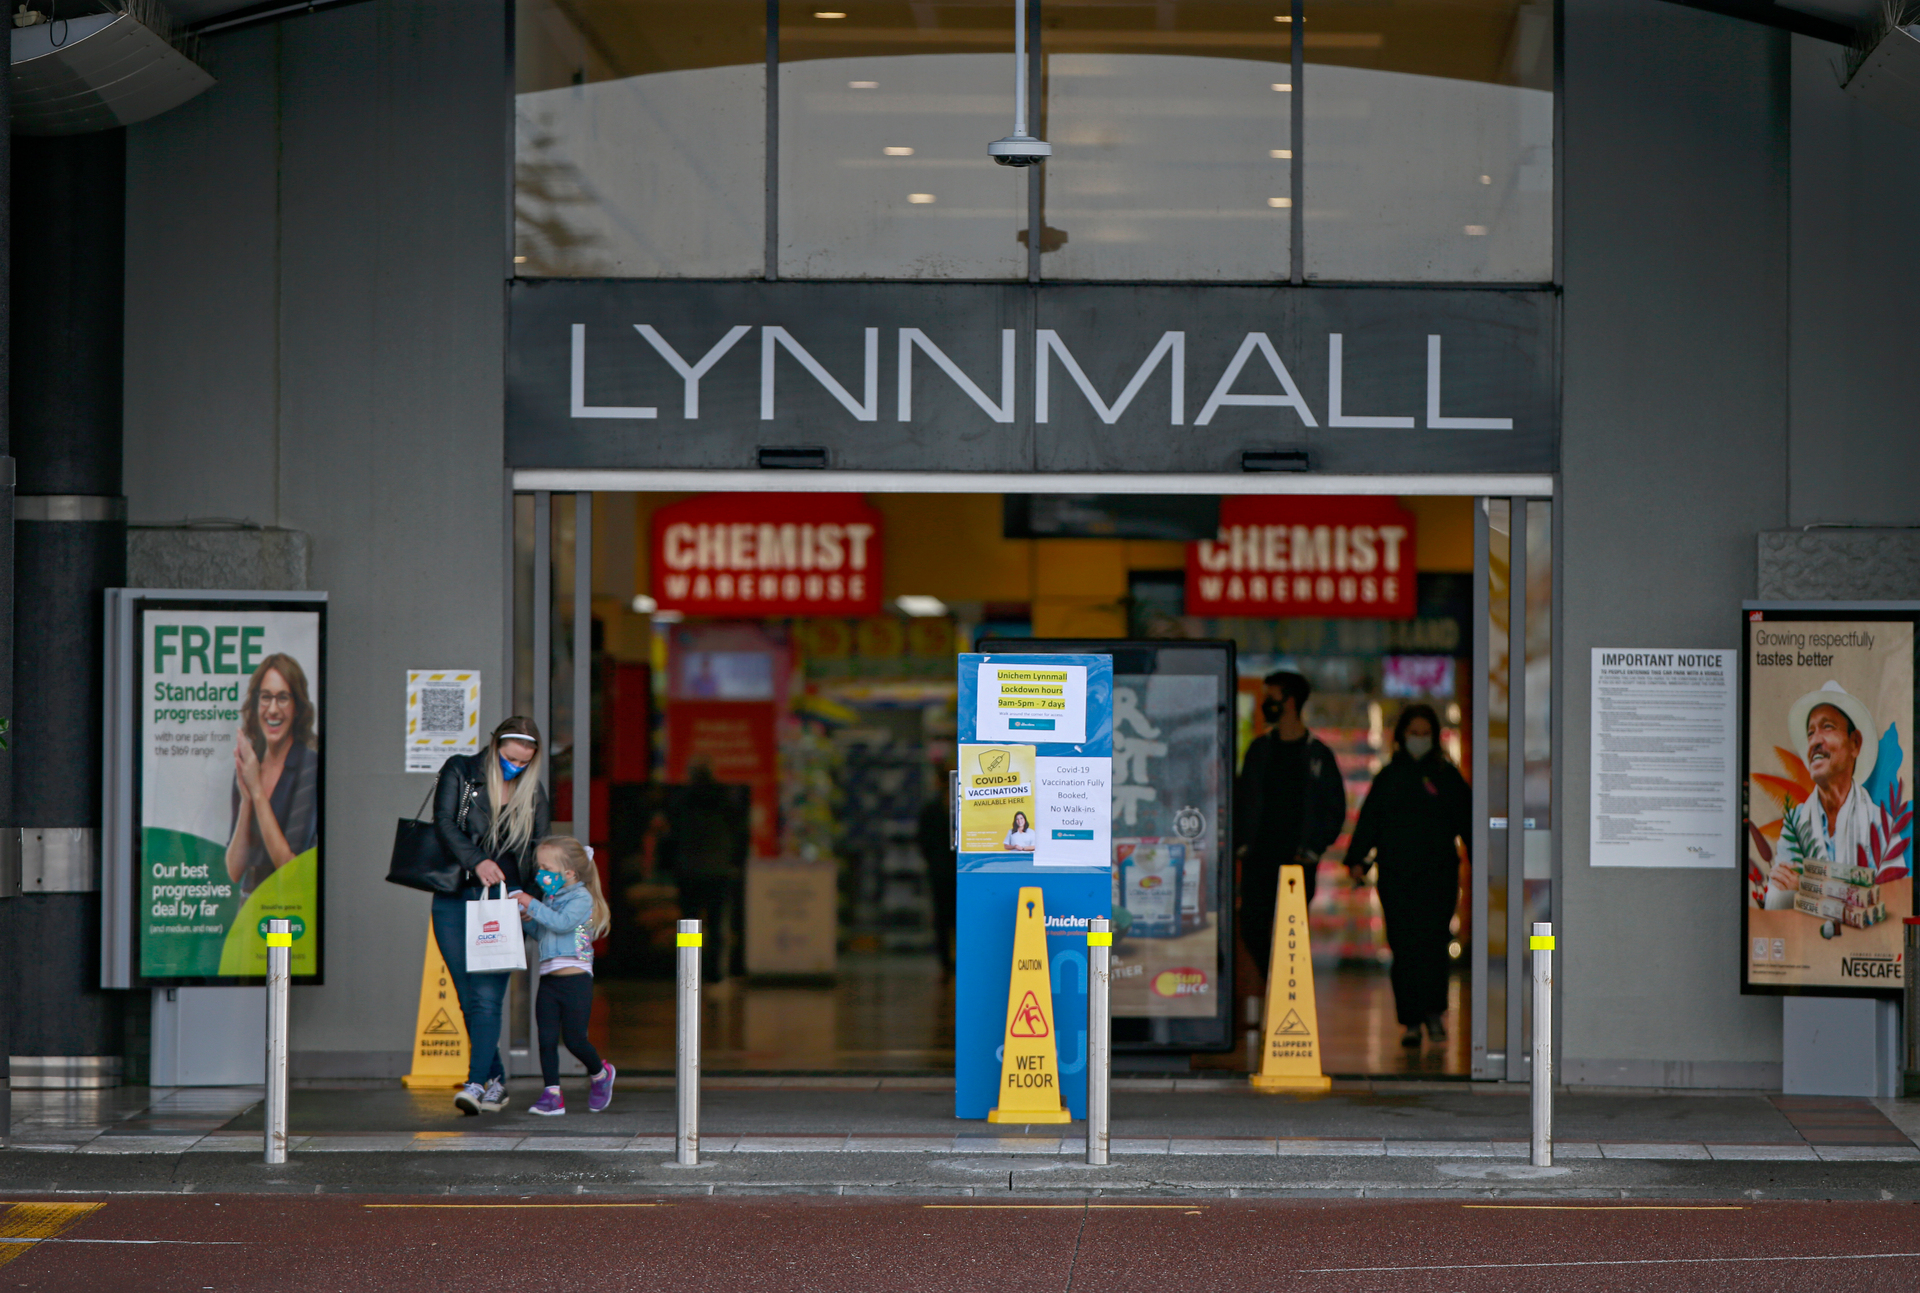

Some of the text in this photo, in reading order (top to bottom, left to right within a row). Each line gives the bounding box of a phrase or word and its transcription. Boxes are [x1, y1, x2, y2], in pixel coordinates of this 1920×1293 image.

[570, 323, 1514, 430] LYNNMALL
[664, 522, 874, 572] CHEMIST
[1198, 524, 1407, 573] CHEMIST
[664, 574, 865, 601] WAREHOUSE
[1199, 575, 1398, 603] WAREHOUSE
[1756, 629, 1875, 650] Growing respectfully
[154, 625, 265, 674] FREE
[1602, 653, 1723, 667] IMPORTANT NOTICE
[1756, 651, 1834, 666] tastes better
[997, 672, 1067, 681] Unichem Lynnmall
[154, 681, 239, 701] Standard
[1001, 686, 1063, 694] Lockdown hours
[998, 699, 1035, 708] 9am-5pm
[1048, 701, 1066, 709] days
[154, 705, 239, 723] progressives
[155, 731, 231, 743] with one pair from
[155, 745, 169, 755] the
[191, 747, 215, 758] range
[1057, 766, 1090, 774] Covid-19
[975, 775, 1018, 785] COVID-19
[1087, 779, 1105, 787] Fully
[968, 786, 1029, 797] VACCINATIONS
[1058, 792, 1088, 800] Booked,
[973, 799, 1007, 807] AVAILABLE
[1051, 805, 1096, 813] No Walk-ins
[1062, 818, 1084, 827] today
[1180, 815, 1199, 830] 90
[152, 862, 209, 878] Our best
[152, 881, 232, 901] progressives
[152, 900, 219, 920] deal by far
[1044, 915, 1091, 927] Uniche
[478, 933, 497, 941] CLICK
[1018, 959, 1042, 970] CAUTION
[1288, 915, 1296, 1001] CAUTION
[1841, 953, 1902, 979] NESCAFÉ
[1272, 1040, 1313, 1048] SLIPPERY
[1016, 1055, 1045, 1070] WET
[1008, 1073, 1053, 1088] FLOOR
